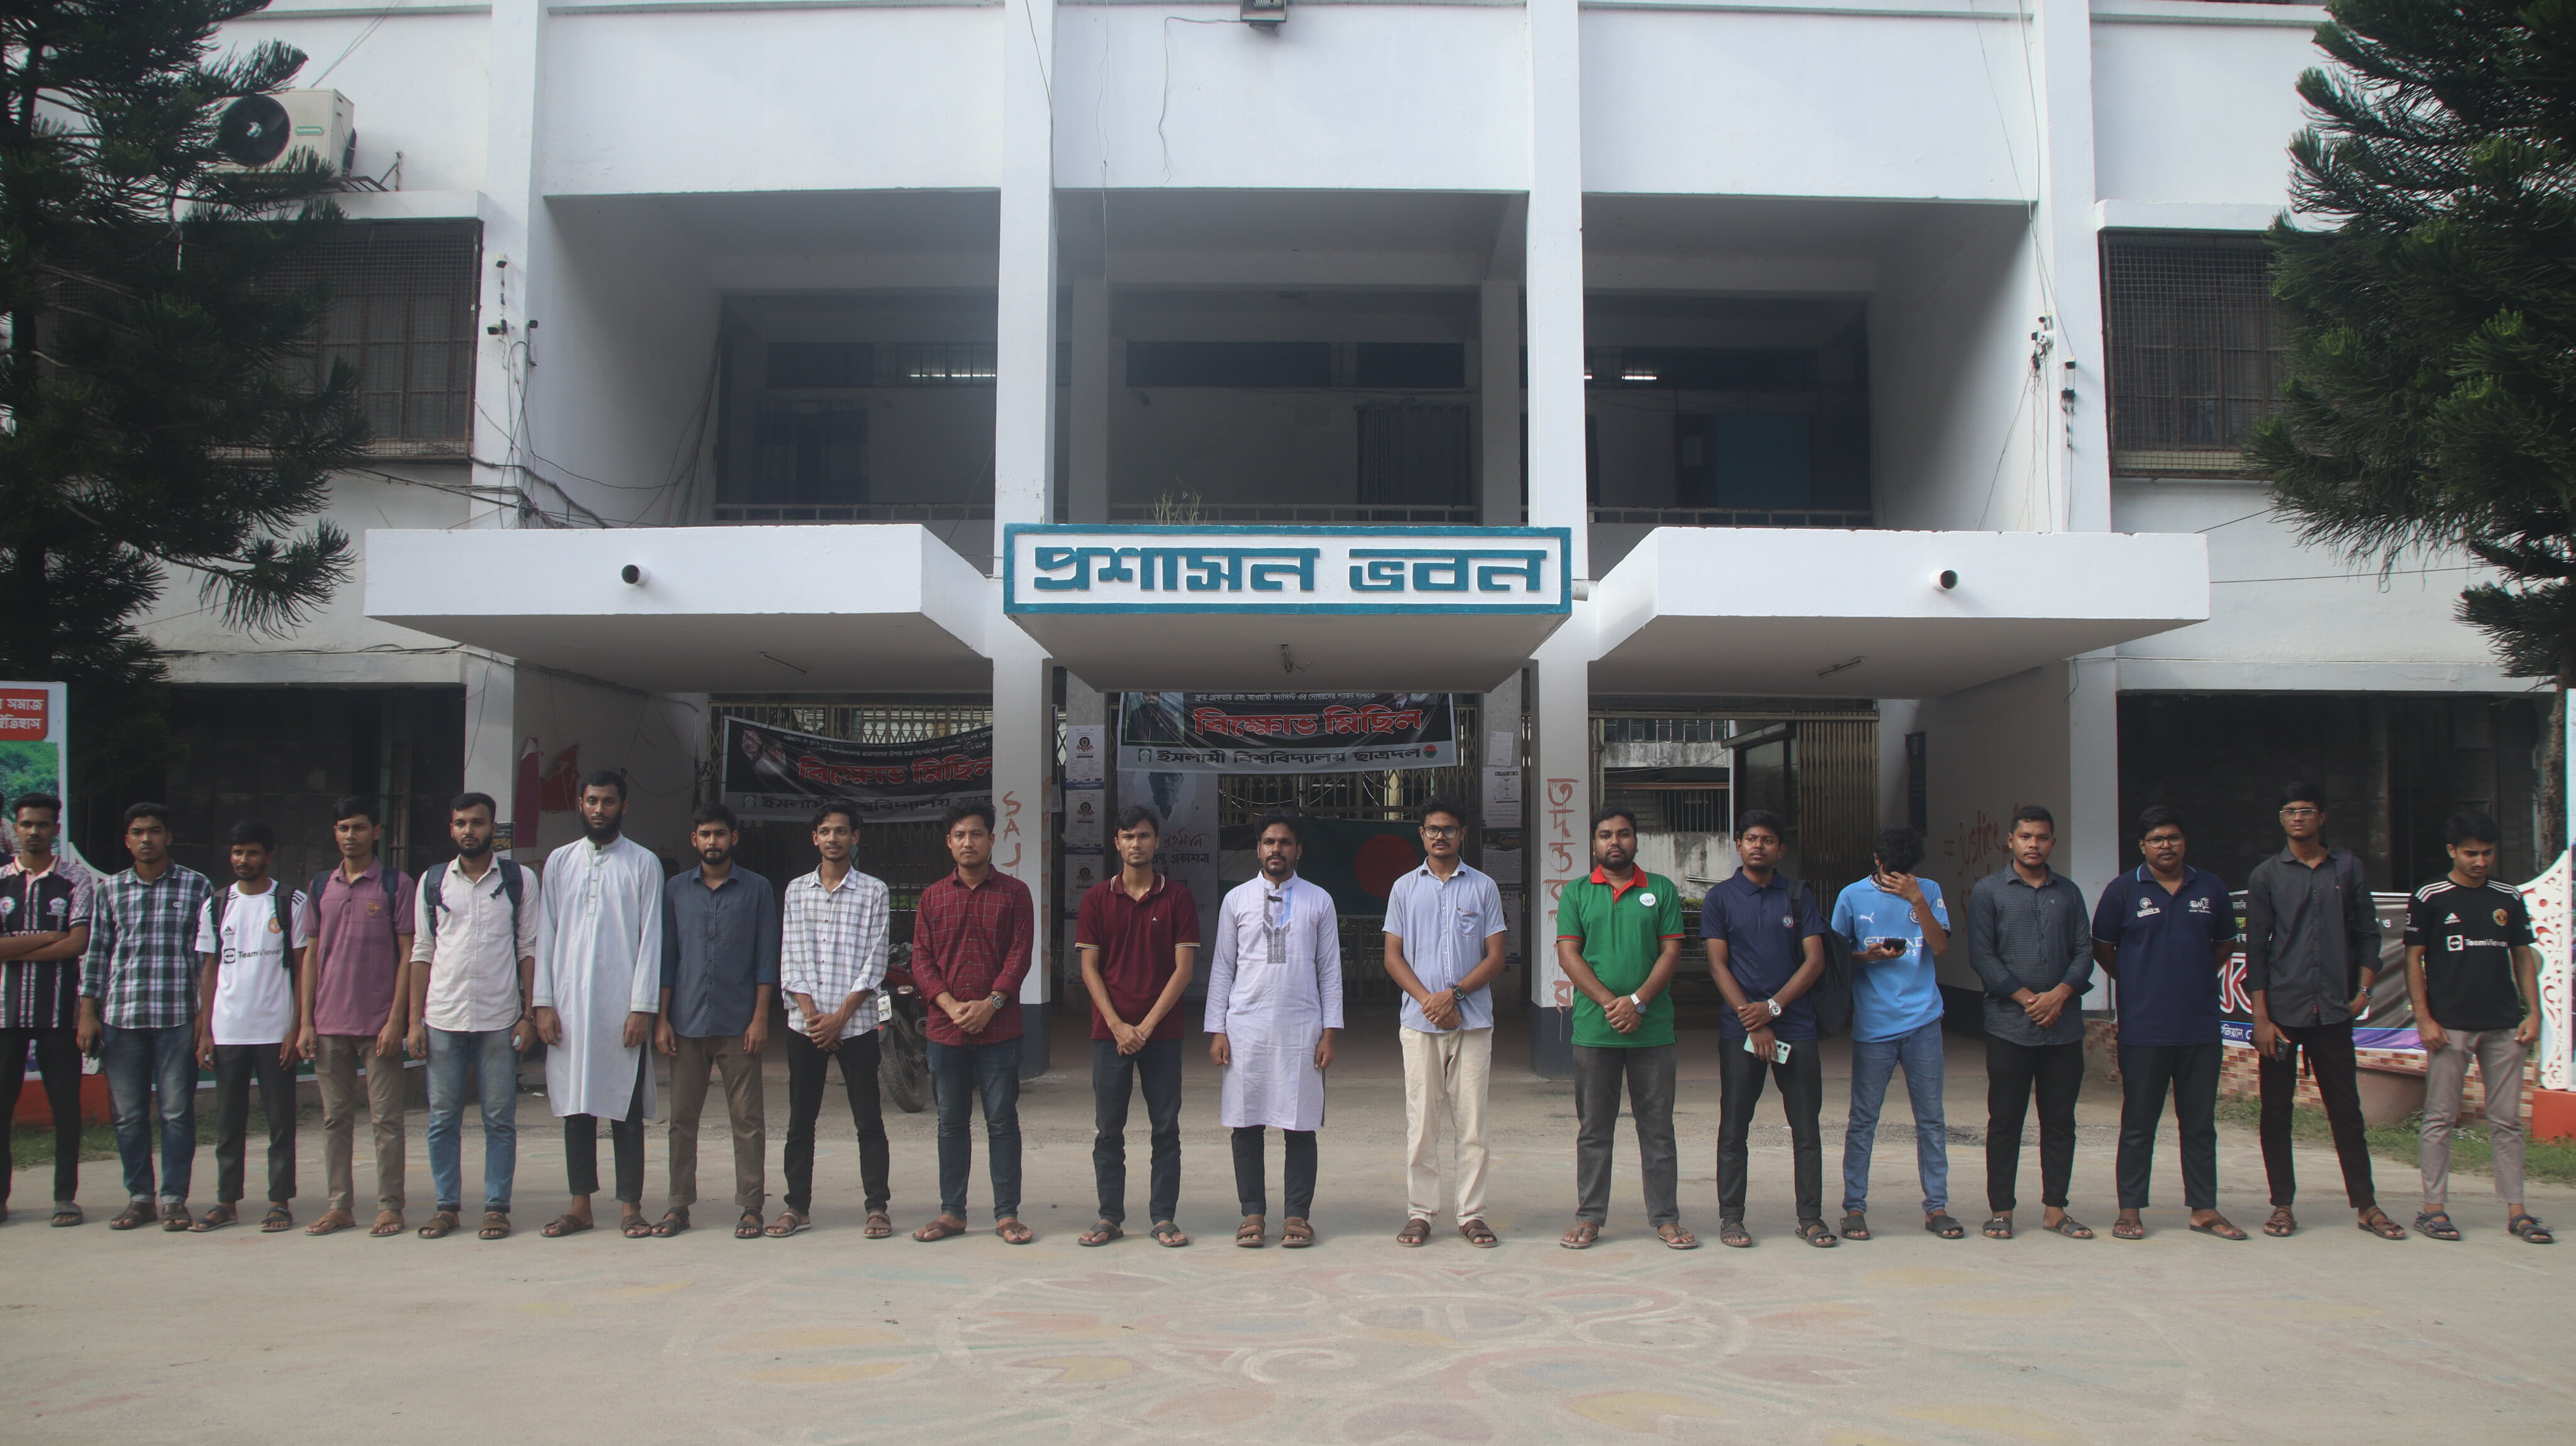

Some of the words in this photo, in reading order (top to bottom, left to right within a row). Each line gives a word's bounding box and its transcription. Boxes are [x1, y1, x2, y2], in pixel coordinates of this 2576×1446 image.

[1034, 546, 1320, 592] প্রশাসন
[1348, 548, 1547, 592] ভবন
[6, 698, 45, 710] সমাজ
[1234, 694, 1246, 702] এবং
[1192, 707, 1318, 737] বিক্ষোভ
[1323, 704, 1423, 735] মিছিল
[1156, 749, 1226, 765] ইসলামী
[1233, 750, 1346, 765] বিশ্ববিদ্যালয়
[1353, 748, 1421, 762] ছাত্রদল
[797, 755, 907, 785] বিক্ষোভ
[1001, 791, 1022, 878] SAJ
[1863, 935, 1924, 948] ETAD
[2464, 938, 2509, 947] TeamViewer
[237, 948, 282, 959] TeamViewer
